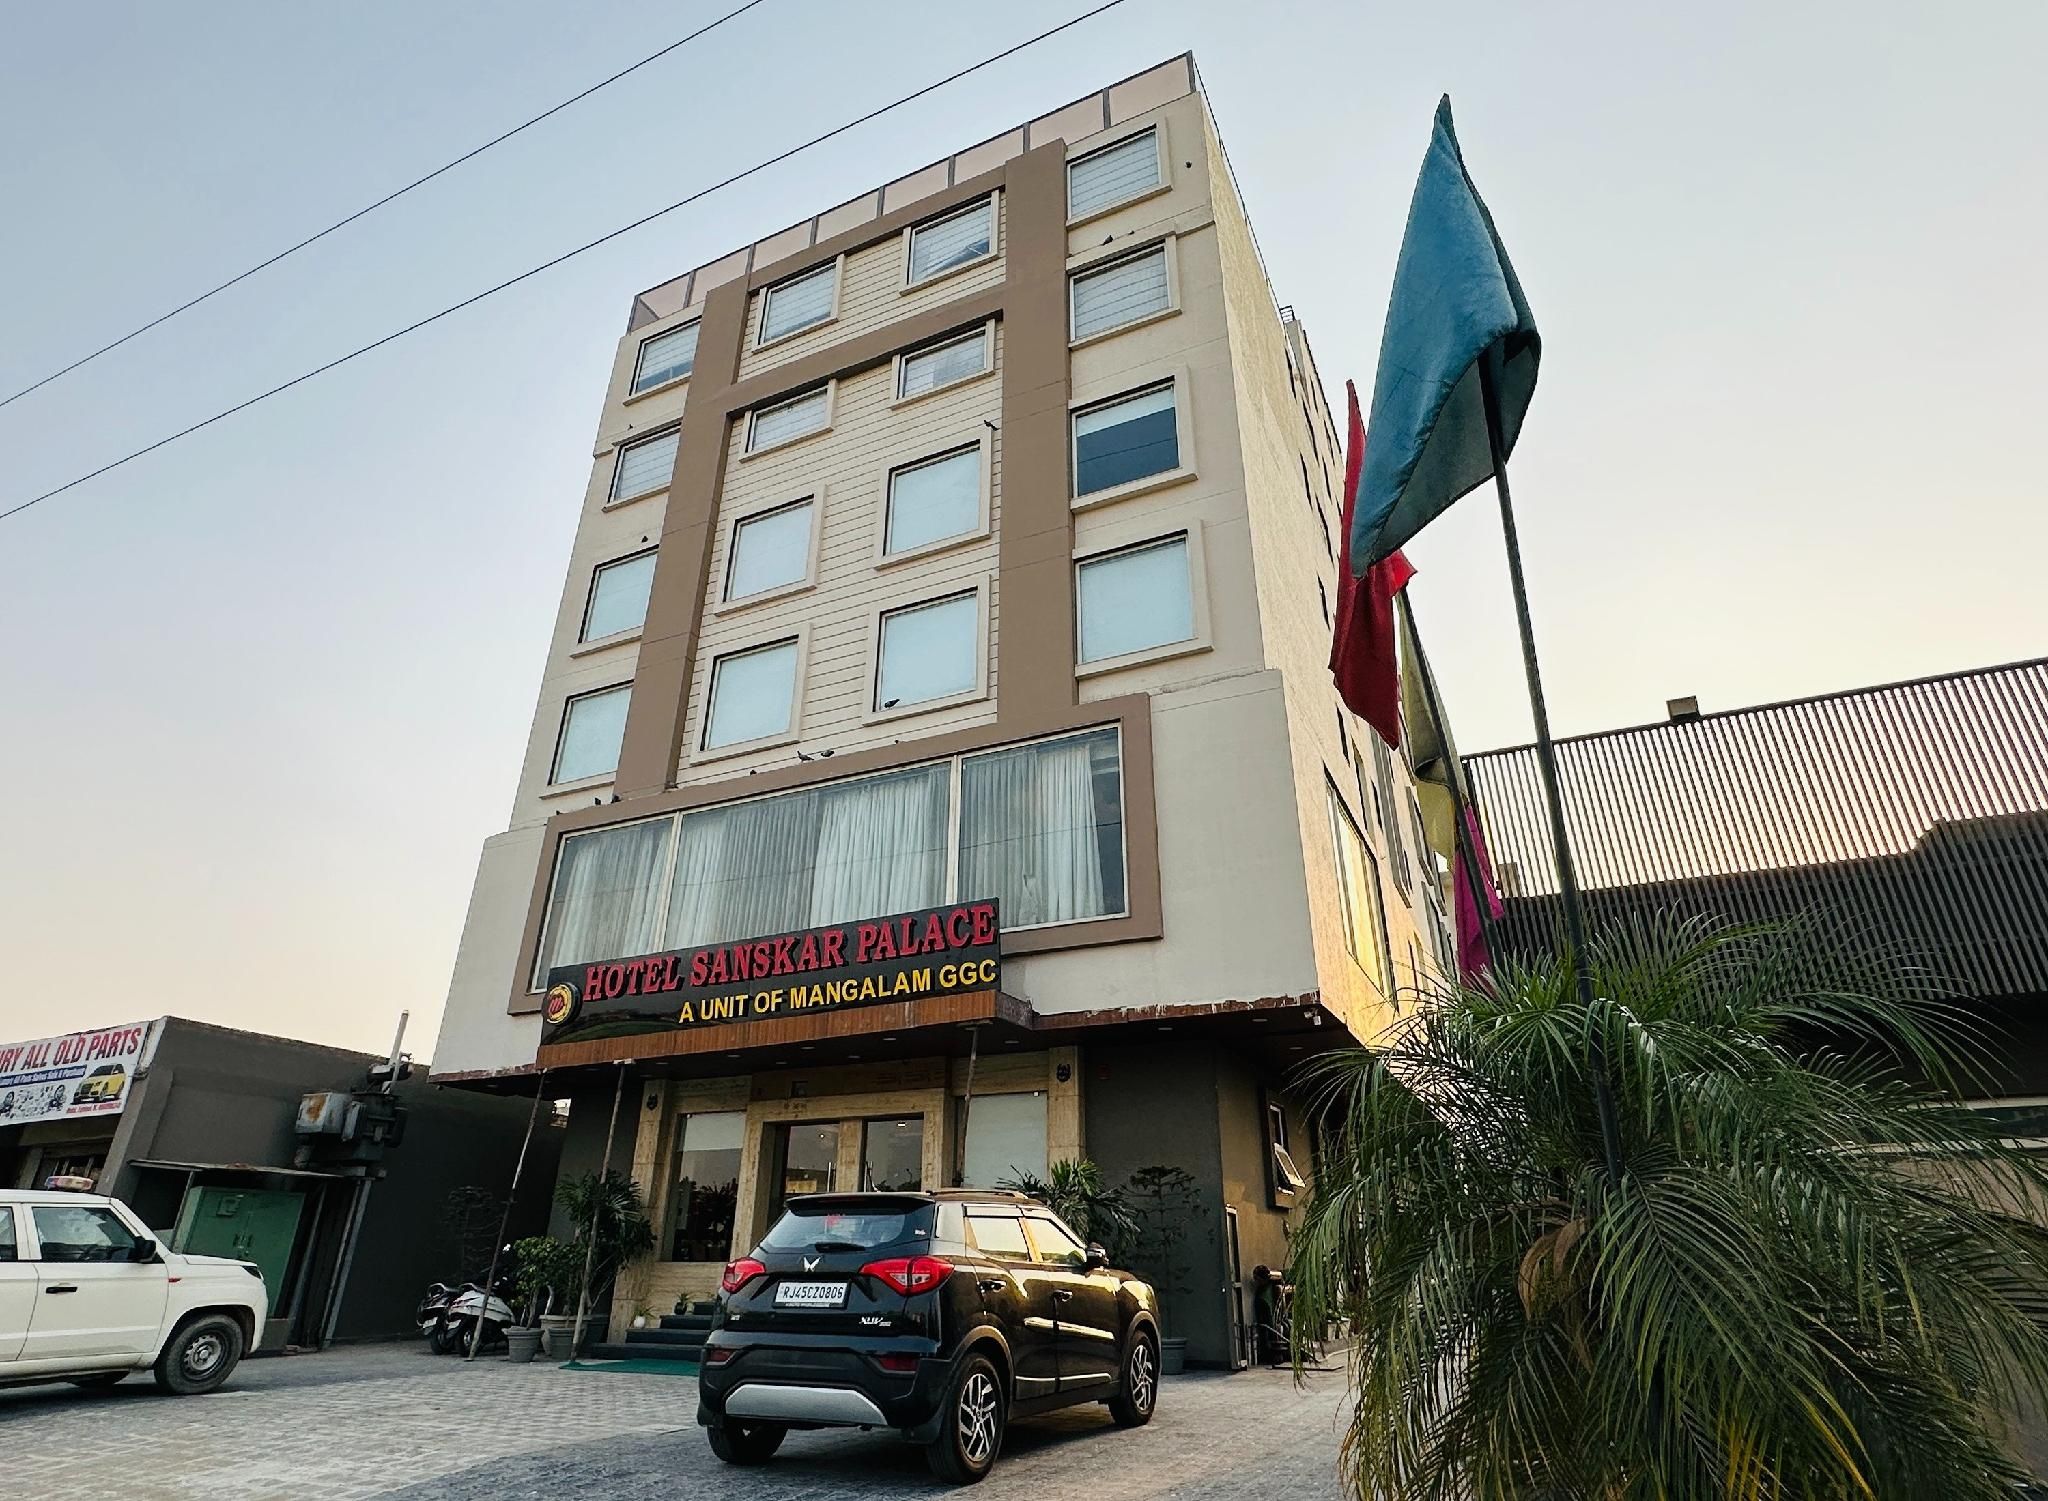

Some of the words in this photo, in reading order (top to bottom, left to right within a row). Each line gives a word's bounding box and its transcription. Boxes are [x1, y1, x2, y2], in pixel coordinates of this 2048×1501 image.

[583, 957, 682, 1001] HOTEL
[690, 929, 845, 987] SANSKAR
[857, 903, 997, 962] PALACE
[678, 1001, 694, 1024] A
[701, 993, 749, 1020] UNIT
[753, 988, 783, 1013] OF
[790, 967, 932, 1009] MANGALAM
[939, 958, 997, 988] GGC
[21, 1043, 51, 1070] ALL
[53, 1036, 86, 1066] OLD
[85, 1027, 142, 1061] PARTS
